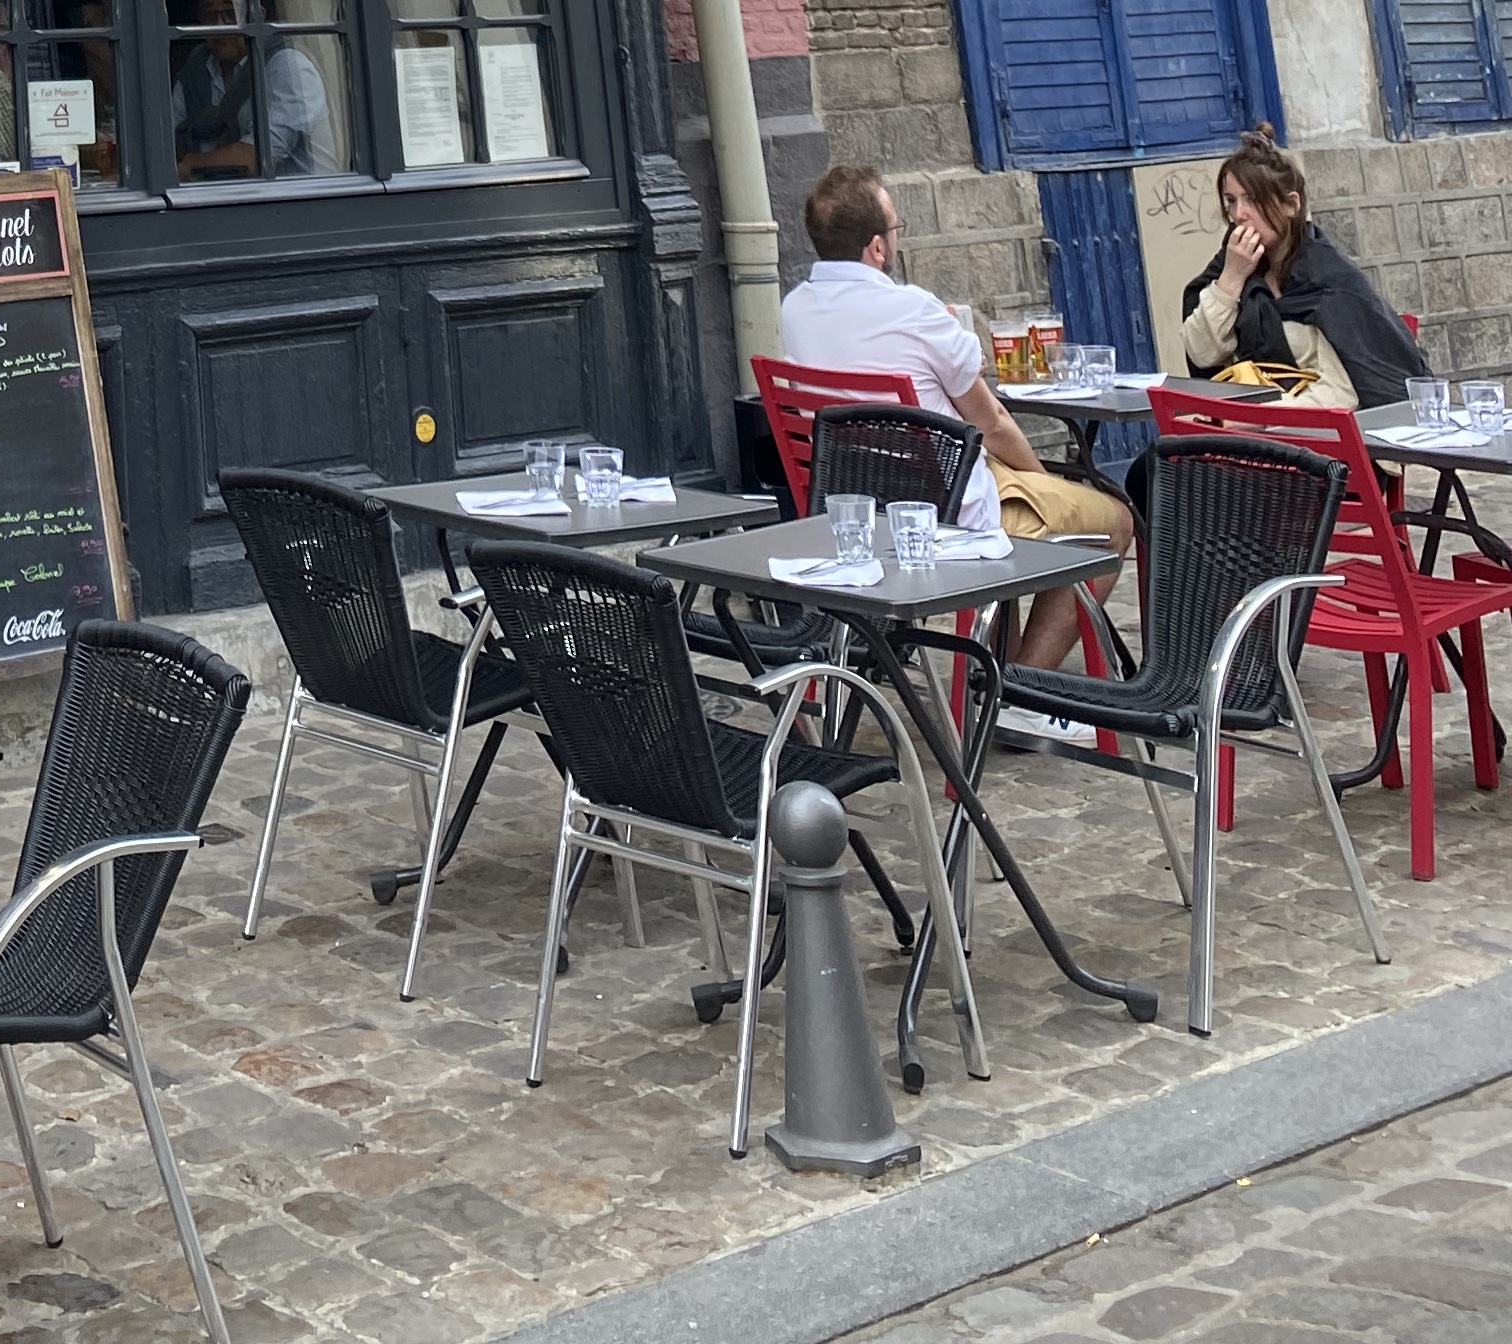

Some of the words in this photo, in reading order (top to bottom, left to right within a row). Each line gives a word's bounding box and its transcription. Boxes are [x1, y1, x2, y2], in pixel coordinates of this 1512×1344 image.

[40, 88, 53, 97] Fait
[54, 87, 80, 97] Maison
[3, 608, 67, 645] Coca-Cola
